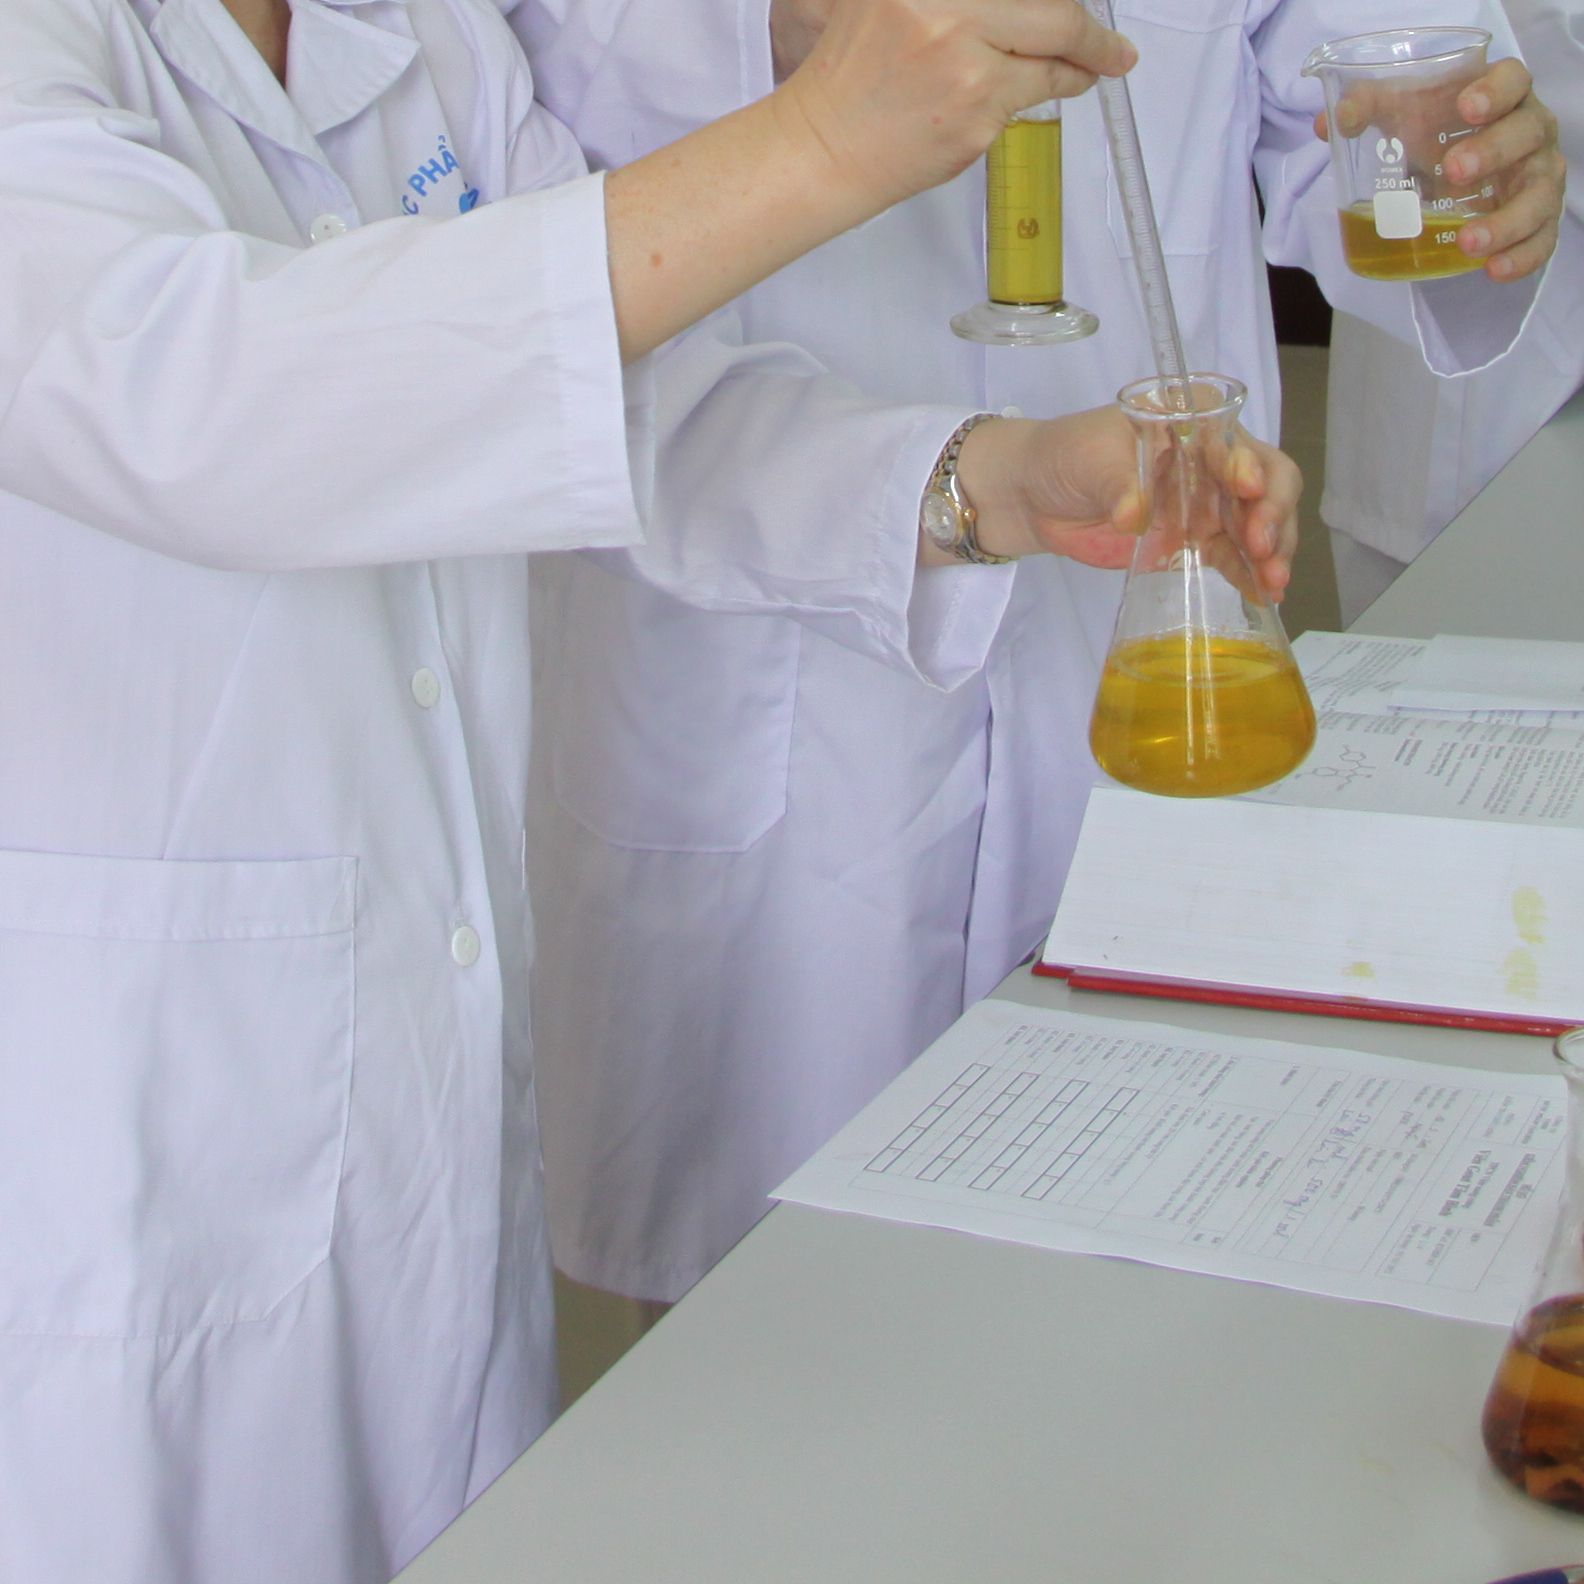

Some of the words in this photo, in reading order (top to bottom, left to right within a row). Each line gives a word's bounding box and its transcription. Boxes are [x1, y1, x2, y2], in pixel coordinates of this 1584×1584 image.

[1375, 178, 1397, 190] 250
[1399, 176, 1416, 189] ml
[1431, 197, 1454, 211] 100
[1434, 231, 1457, 245] 150
